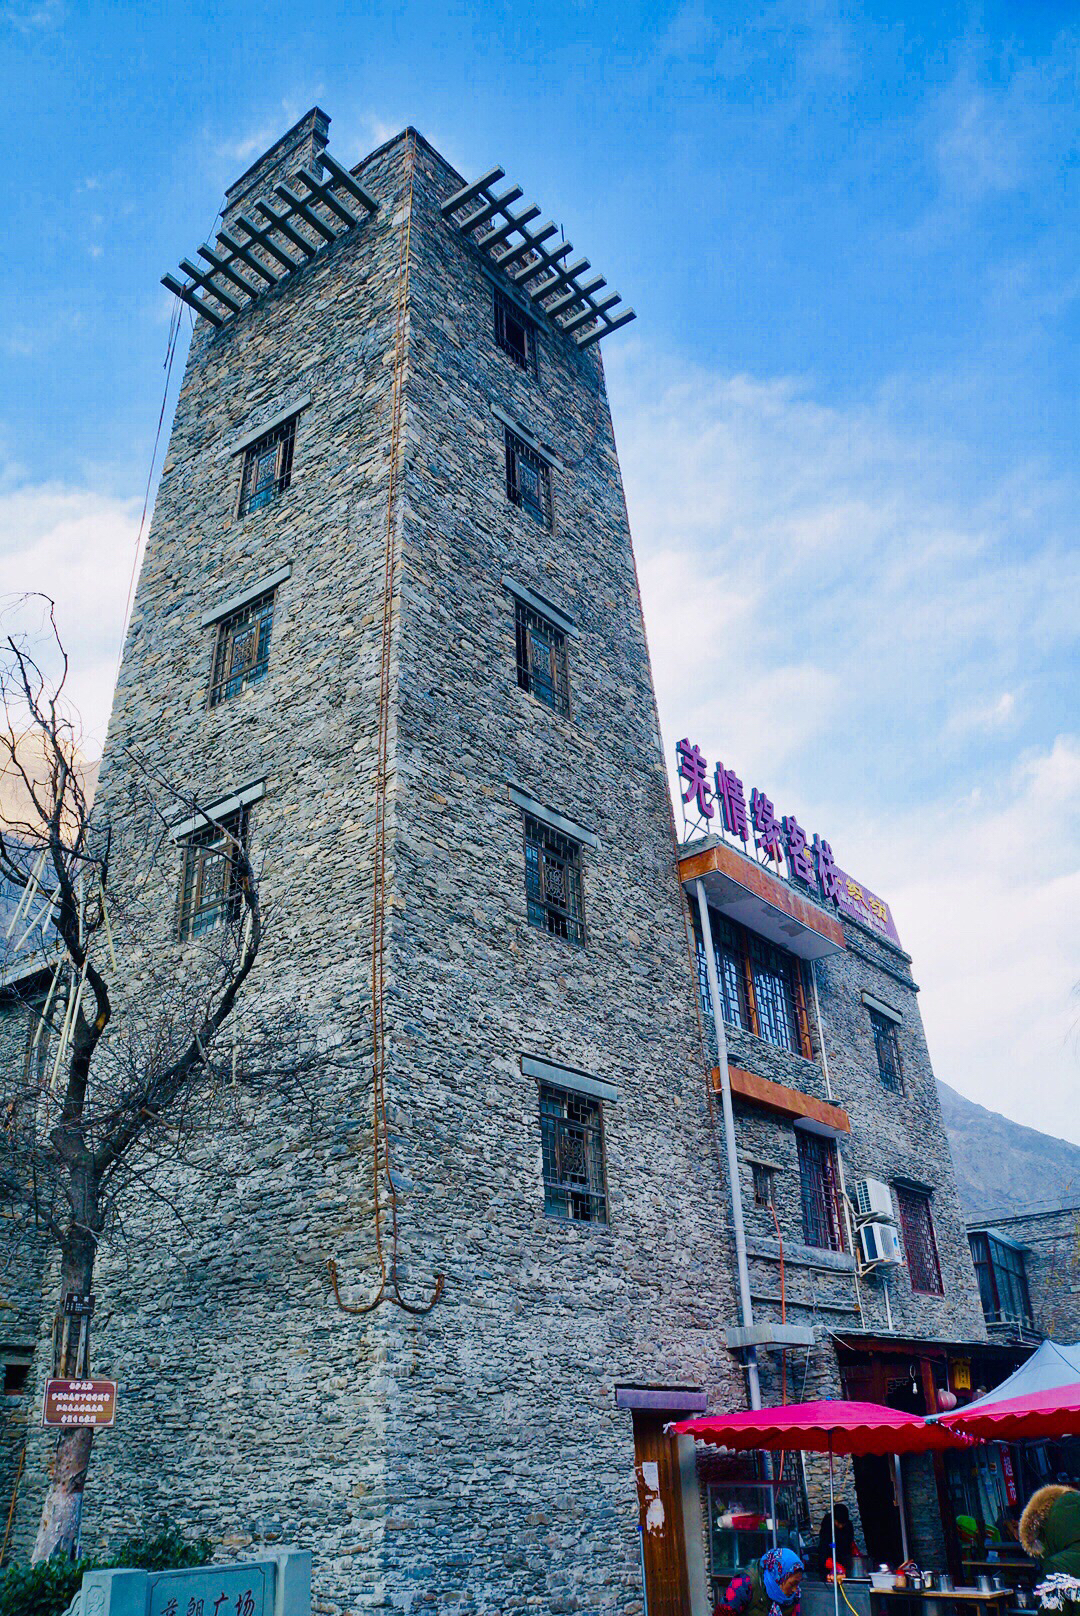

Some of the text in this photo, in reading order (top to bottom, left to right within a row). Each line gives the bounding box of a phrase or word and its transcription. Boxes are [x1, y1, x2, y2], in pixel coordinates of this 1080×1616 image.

[676, 737, 841, 907] 羌情缘客栈
